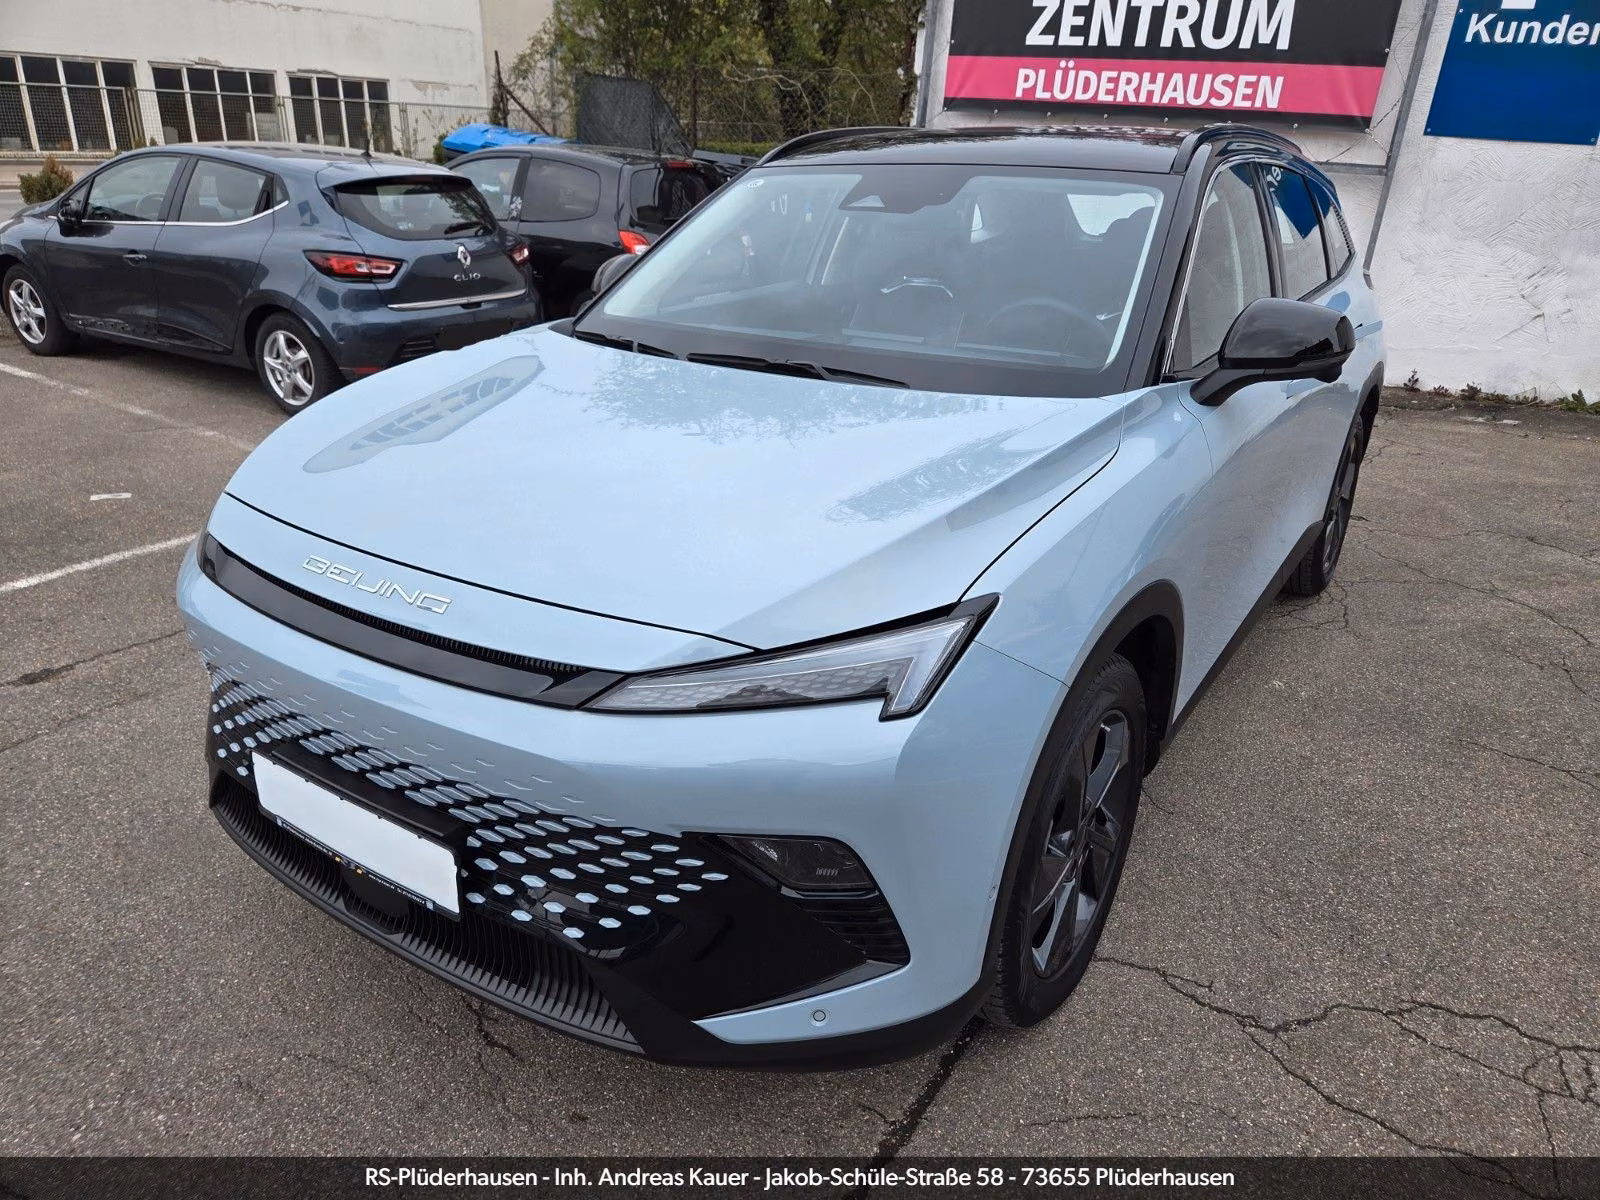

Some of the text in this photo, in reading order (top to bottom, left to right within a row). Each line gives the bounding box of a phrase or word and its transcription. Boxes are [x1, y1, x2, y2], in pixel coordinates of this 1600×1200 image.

[1025, 0, 1296, 50] ZENTRUM
[1015, 59, 1285, 109] PLÜDERHAUSEN
[453, 272, 481, 282] CLIO
[302, 554, 453, 615] BEIJING
